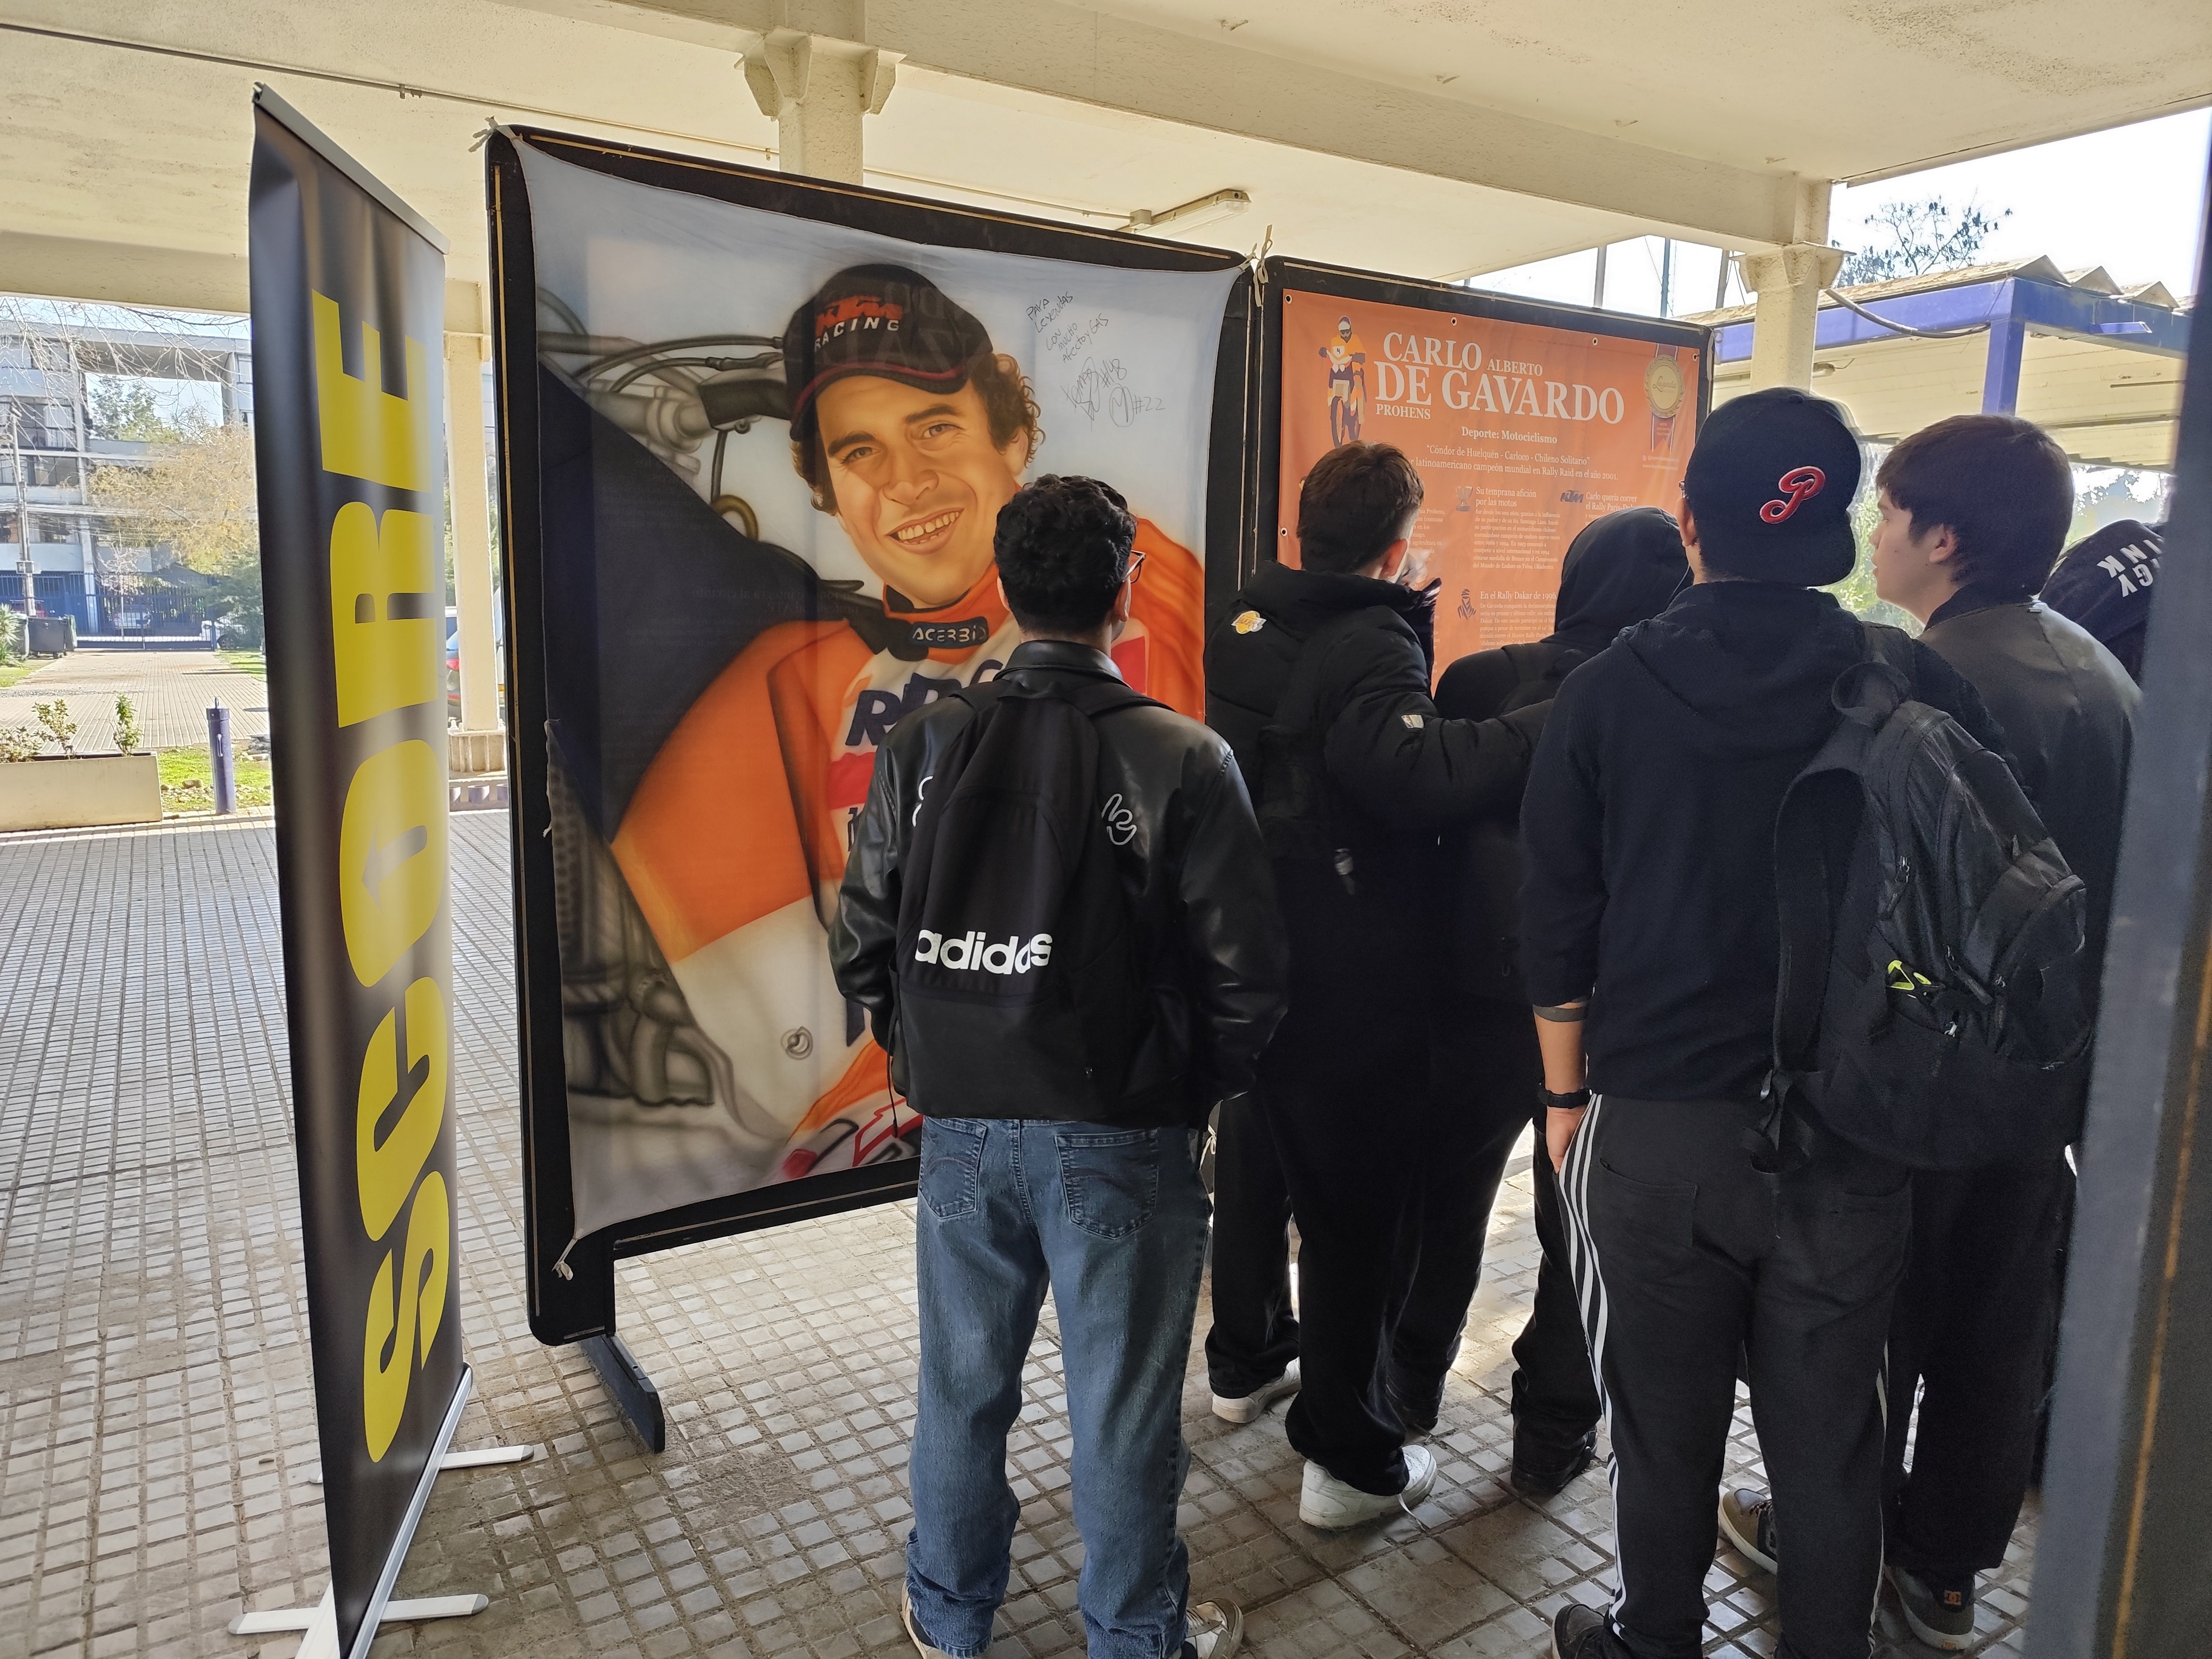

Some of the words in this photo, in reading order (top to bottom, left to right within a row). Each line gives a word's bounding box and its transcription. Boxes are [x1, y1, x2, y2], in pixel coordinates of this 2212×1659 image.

[815, 295, 903, 338] KTM
[814, 317, 899, 352] RACING
[1384, 332, 1482, 371] CARLO
[1487, 358, 1544, 376] ALBERTO
[1373, 361, 1432, 406] DE
[1441, 369, 1625, 425] GAVARDO
[1375, 403, 1431, 420] PROHENS
[1461, 426, 1500, 440] Deporte:
[1501, 430, 1558, 444] Motociclismo
[1456, 446, 1465, 456] de
[1467, 448, 1499, 460] Huelquén
[1504, 451, 1529, 461] Carloco
[1534, 453, 1559, 464] Chileno
[1416, 457, 1472, 470] latinoamericano
[1473, 462, 1503, 473] campeón
[1504, 465, 1532, 474] mundial
[1542, 466, 1559, 478] Rally
[1560, 468, 1574, 477] Raid
[1584, 470, 1590, 478] el
[1590, 471, 1601, 479] año
[1476, 486, 1484, 495] Su
[1486, 488, 1515, 498] temprana
[1516, 488, 1536, 498] afición
[1560, 490, 1584, 503] KTM
[1586, 492, 1600, 500] Carlo
[1602, 493, 1619, 502] quería
[1620, 494, 1638, 503] correr
[1475, 498, 1487, 507] por
[1488, 497, 1496, 506] las
[1585, 501, 1591, 510] el
[1592, 503, 1606, 512] Rally
[1480, 591, 1489, 599] En
[1490, 591, 1496, 599] el
[1497, 591, 1513, 601] Rally
[1514, 591, 1533, 600] Dakar
[1533, 591, 1541, 600] de
[312, 291, 450, 1461] SCORE
[915, 929, 1053, 975] adidas
